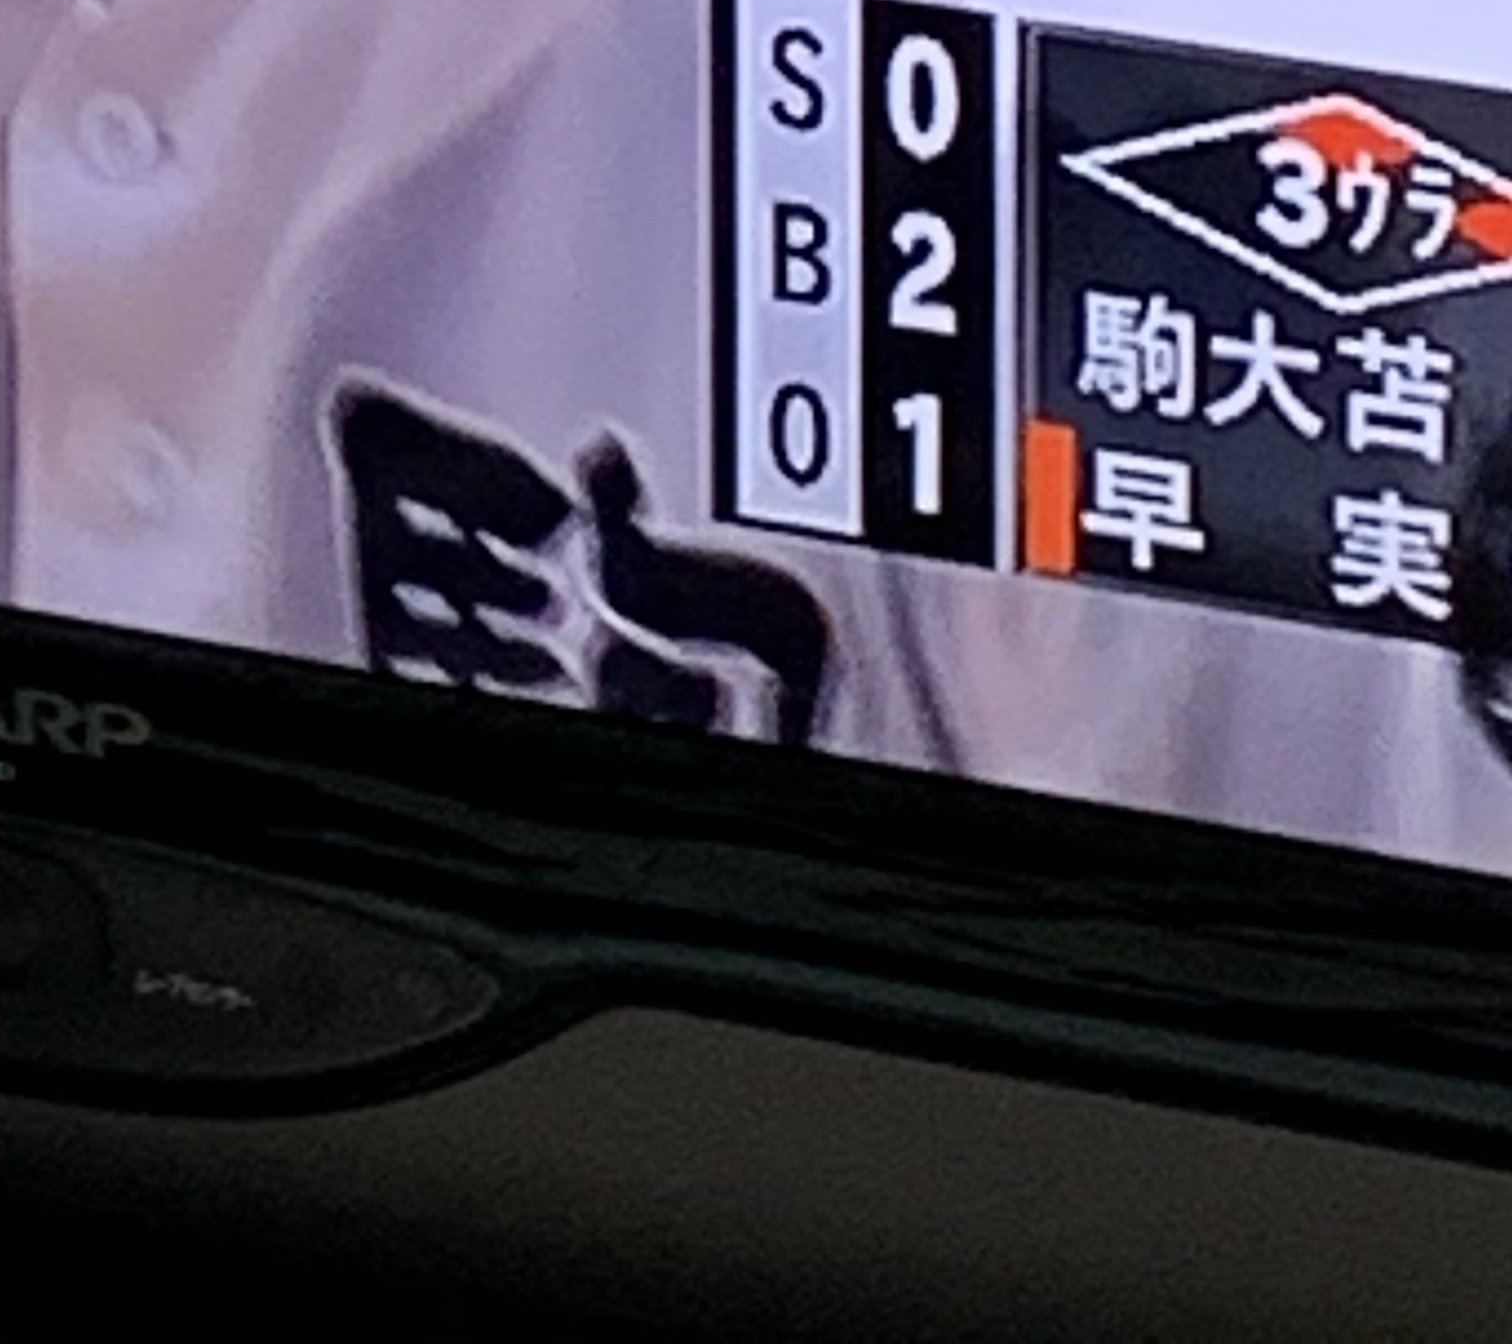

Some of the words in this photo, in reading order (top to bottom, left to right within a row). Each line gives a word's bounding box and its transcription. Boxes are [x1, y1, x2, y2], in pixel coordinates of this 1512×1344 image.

[769, 27, 825, 132] S
[886, 33, 960, 162] 0
[1254, 137, 1458, 259] 3ウラ
[771, 201, 831, 307] B
[888, 210, 958, 335] 2
[1076, 290, 1456, 466] 駒大苫
[891, 392, 942, 516] 1
